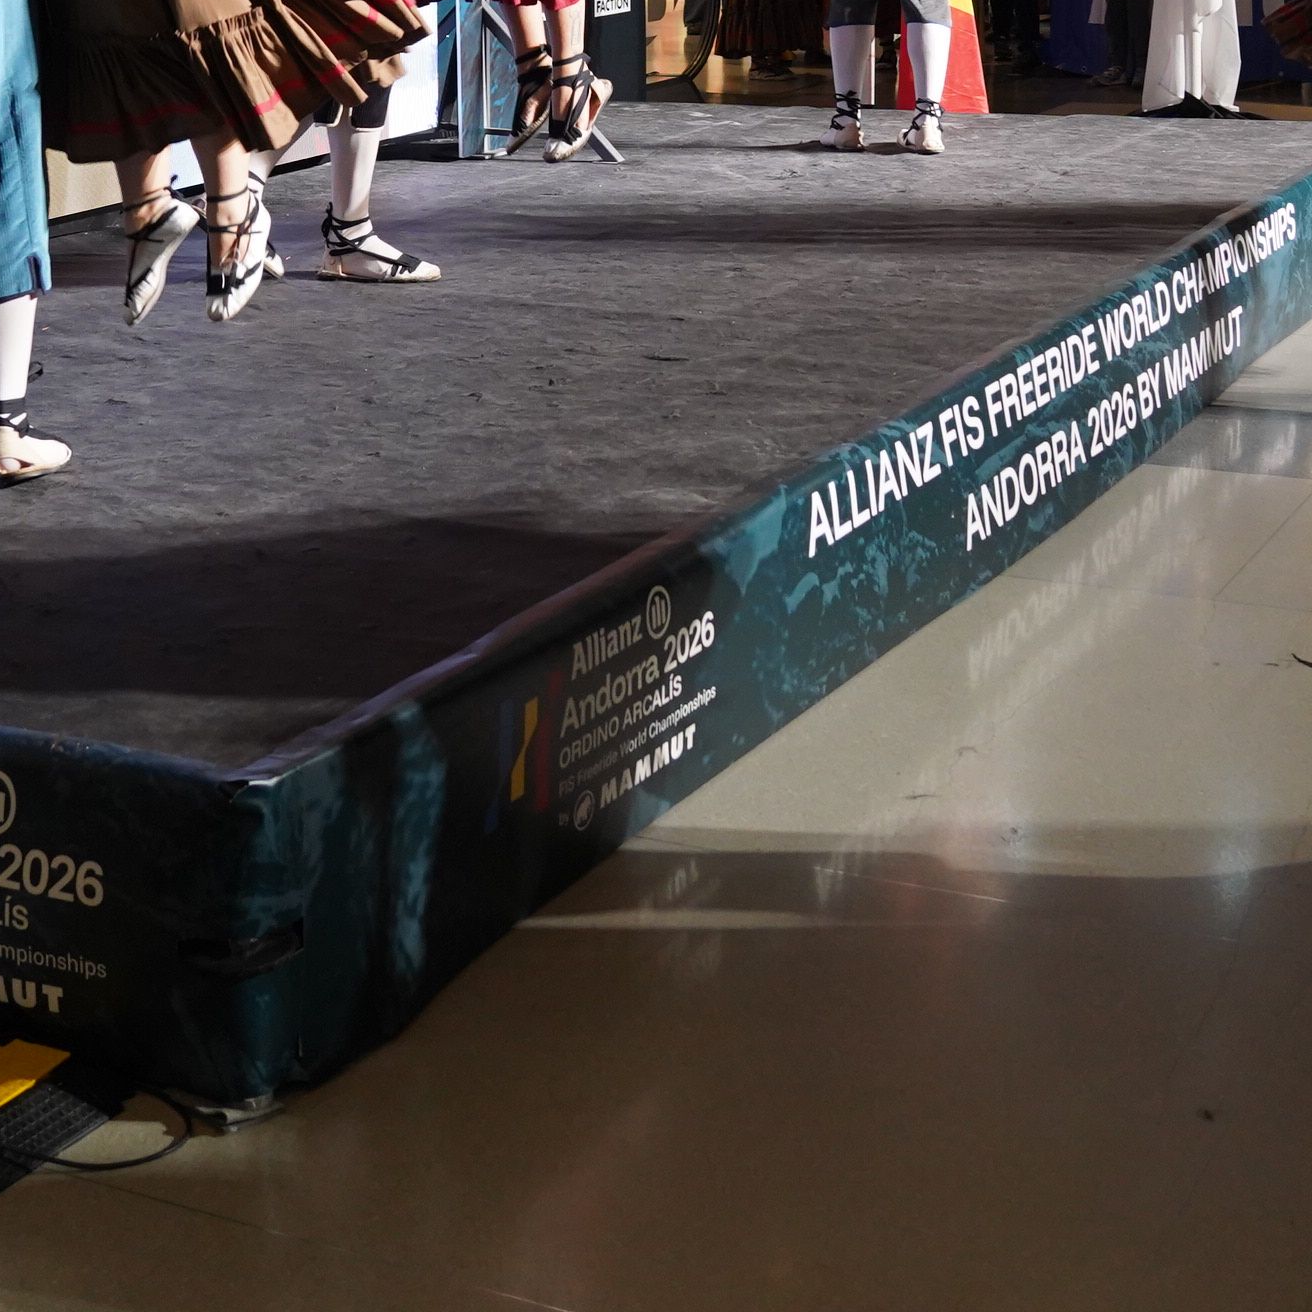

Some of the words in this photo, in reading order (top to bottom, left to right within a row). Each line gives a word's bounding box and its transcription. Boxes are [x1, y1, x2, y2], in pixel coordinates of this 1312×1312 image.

[807, 420, 942, 558] ALLIANZ
[939, 398, 986, 458] FIS
[984, 324, 1097, 435] FREERIDE
[1098, 281, 1172, 363] WORLD
[1171, 202, 1297, 313] CHAMPIONSHIPS
[966, 429, 1088, 552] ANDORRA
[1087, 388, 1138, 458] 2026
[1137, 367, 1165, 423] BY
[1163, 305, 1244, 395] MAMMUT
[559, 654, 660, 738] Andorra
[663, 609, 716, 673] 2026
[571, 615, 643, 681] Allianz
[559, 716, 620, 769] ORDINO
[622, 672, 683, 730] ARCALÍS
[599, 722, 697, 809] MAMMUT
[620, 726, 648, 756] World
[648, 685, 717, 739] Championships
